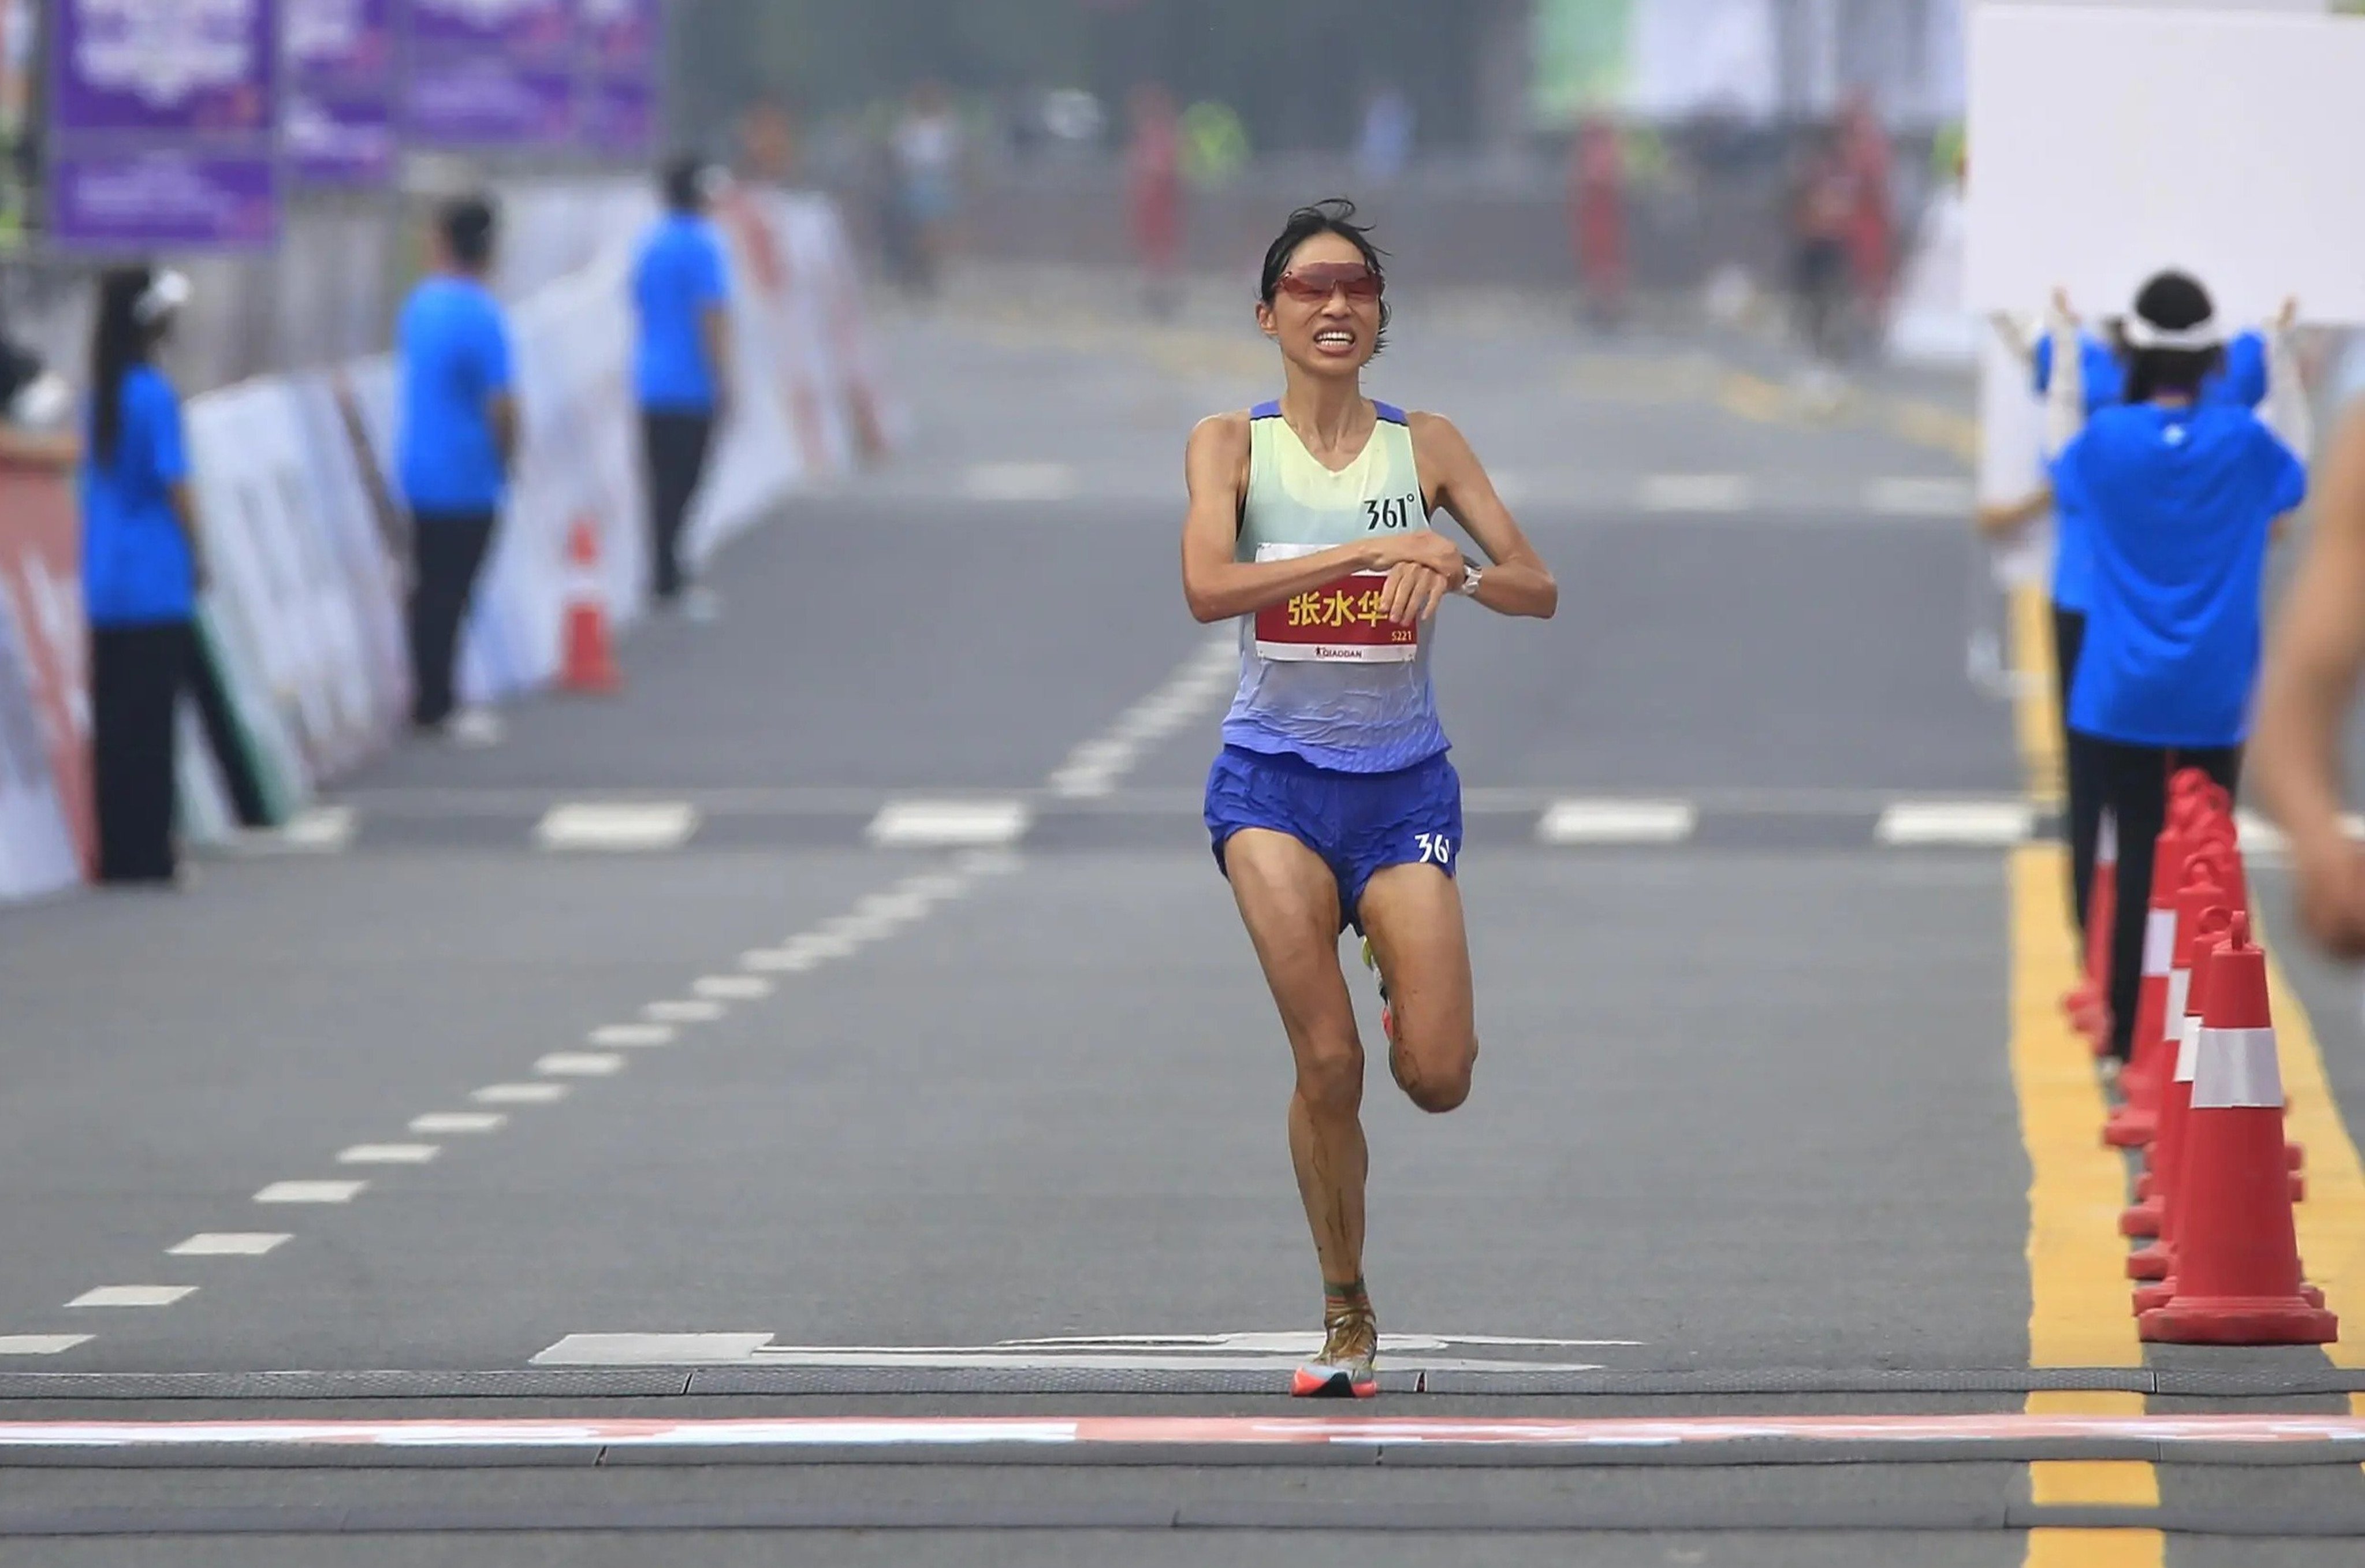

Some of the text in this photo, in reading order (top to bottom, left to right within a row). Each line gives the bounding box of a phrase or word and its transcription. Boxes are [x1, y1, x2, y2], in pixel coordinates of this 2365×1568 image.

[1364, 493, 1414, 530] 361°
[1288, 590, 1388, 627] 张水华
